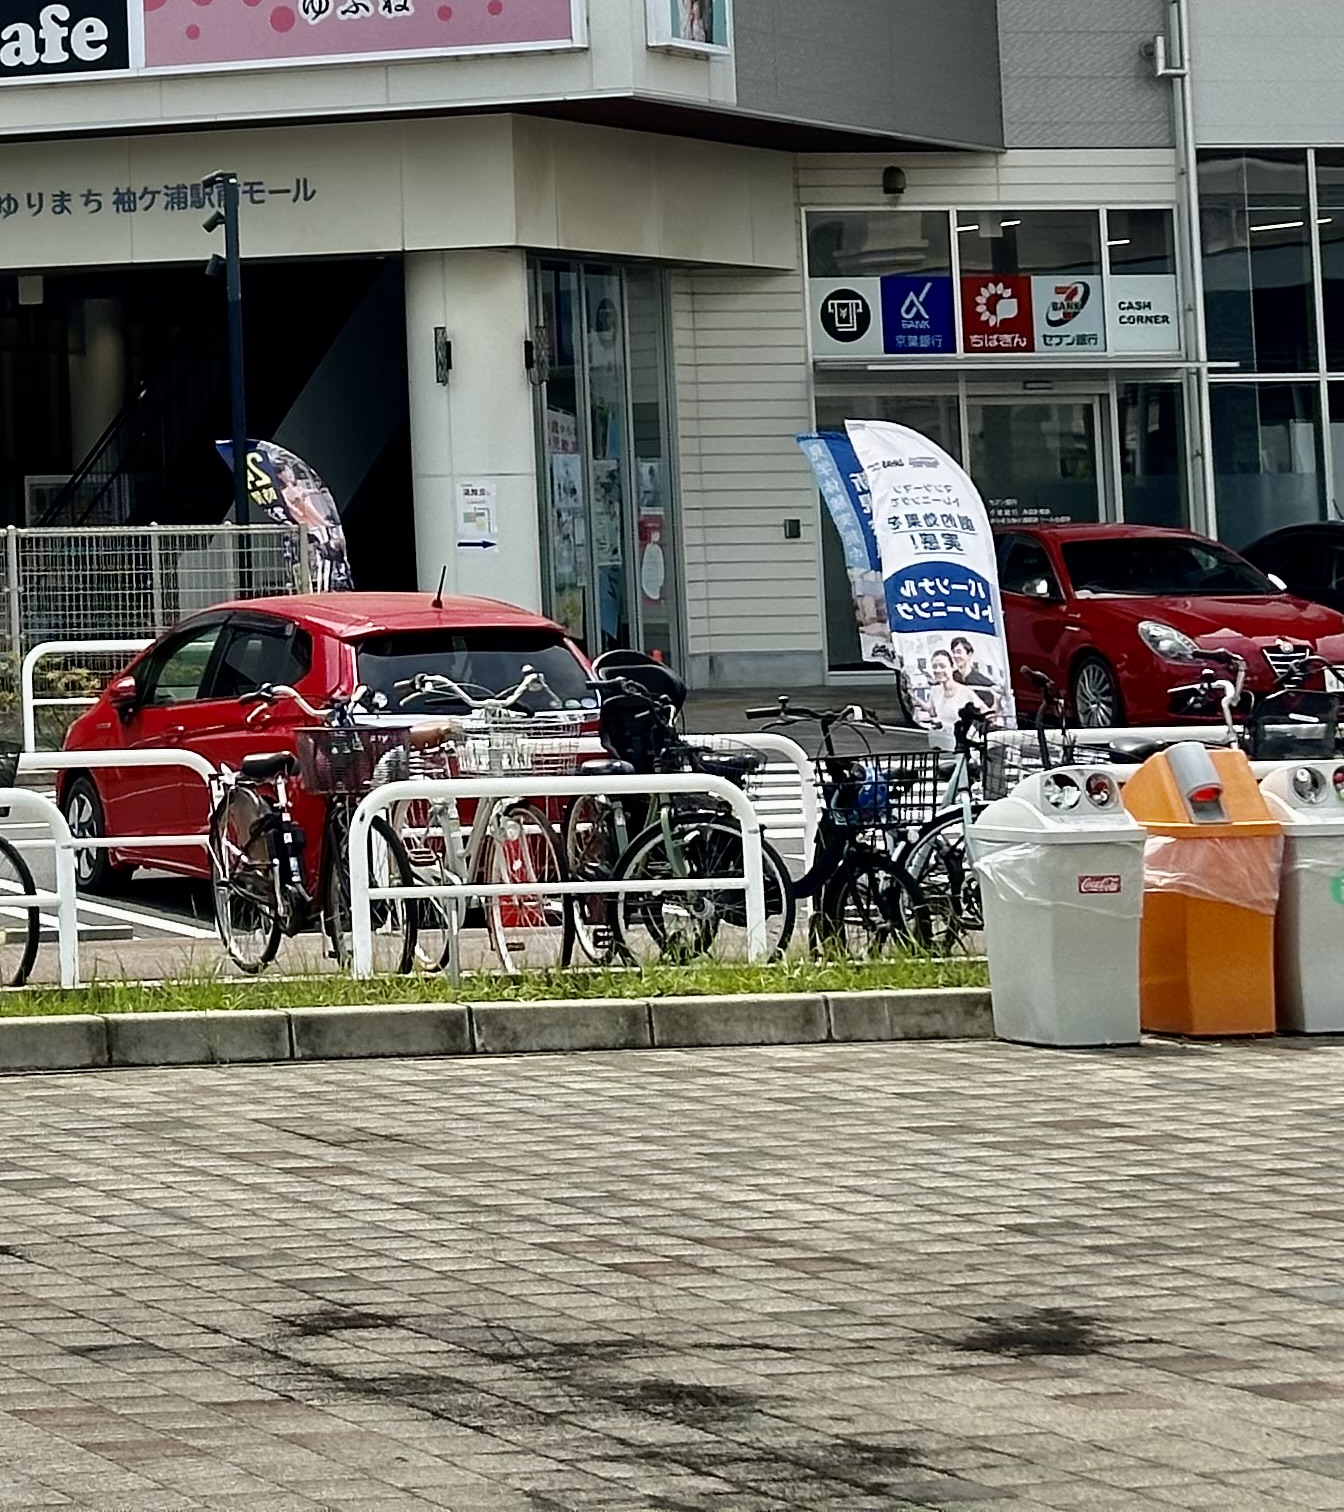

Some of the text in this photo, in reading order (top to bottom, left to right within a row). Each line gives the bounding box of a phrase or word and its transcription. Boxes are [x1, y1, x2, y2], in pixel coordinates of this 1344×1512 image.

[1118, 301, 1152, 311] CASH
[1118, 315, 1170, 325] CORNER
[969, 334, 1027, 348] ちばぎん
